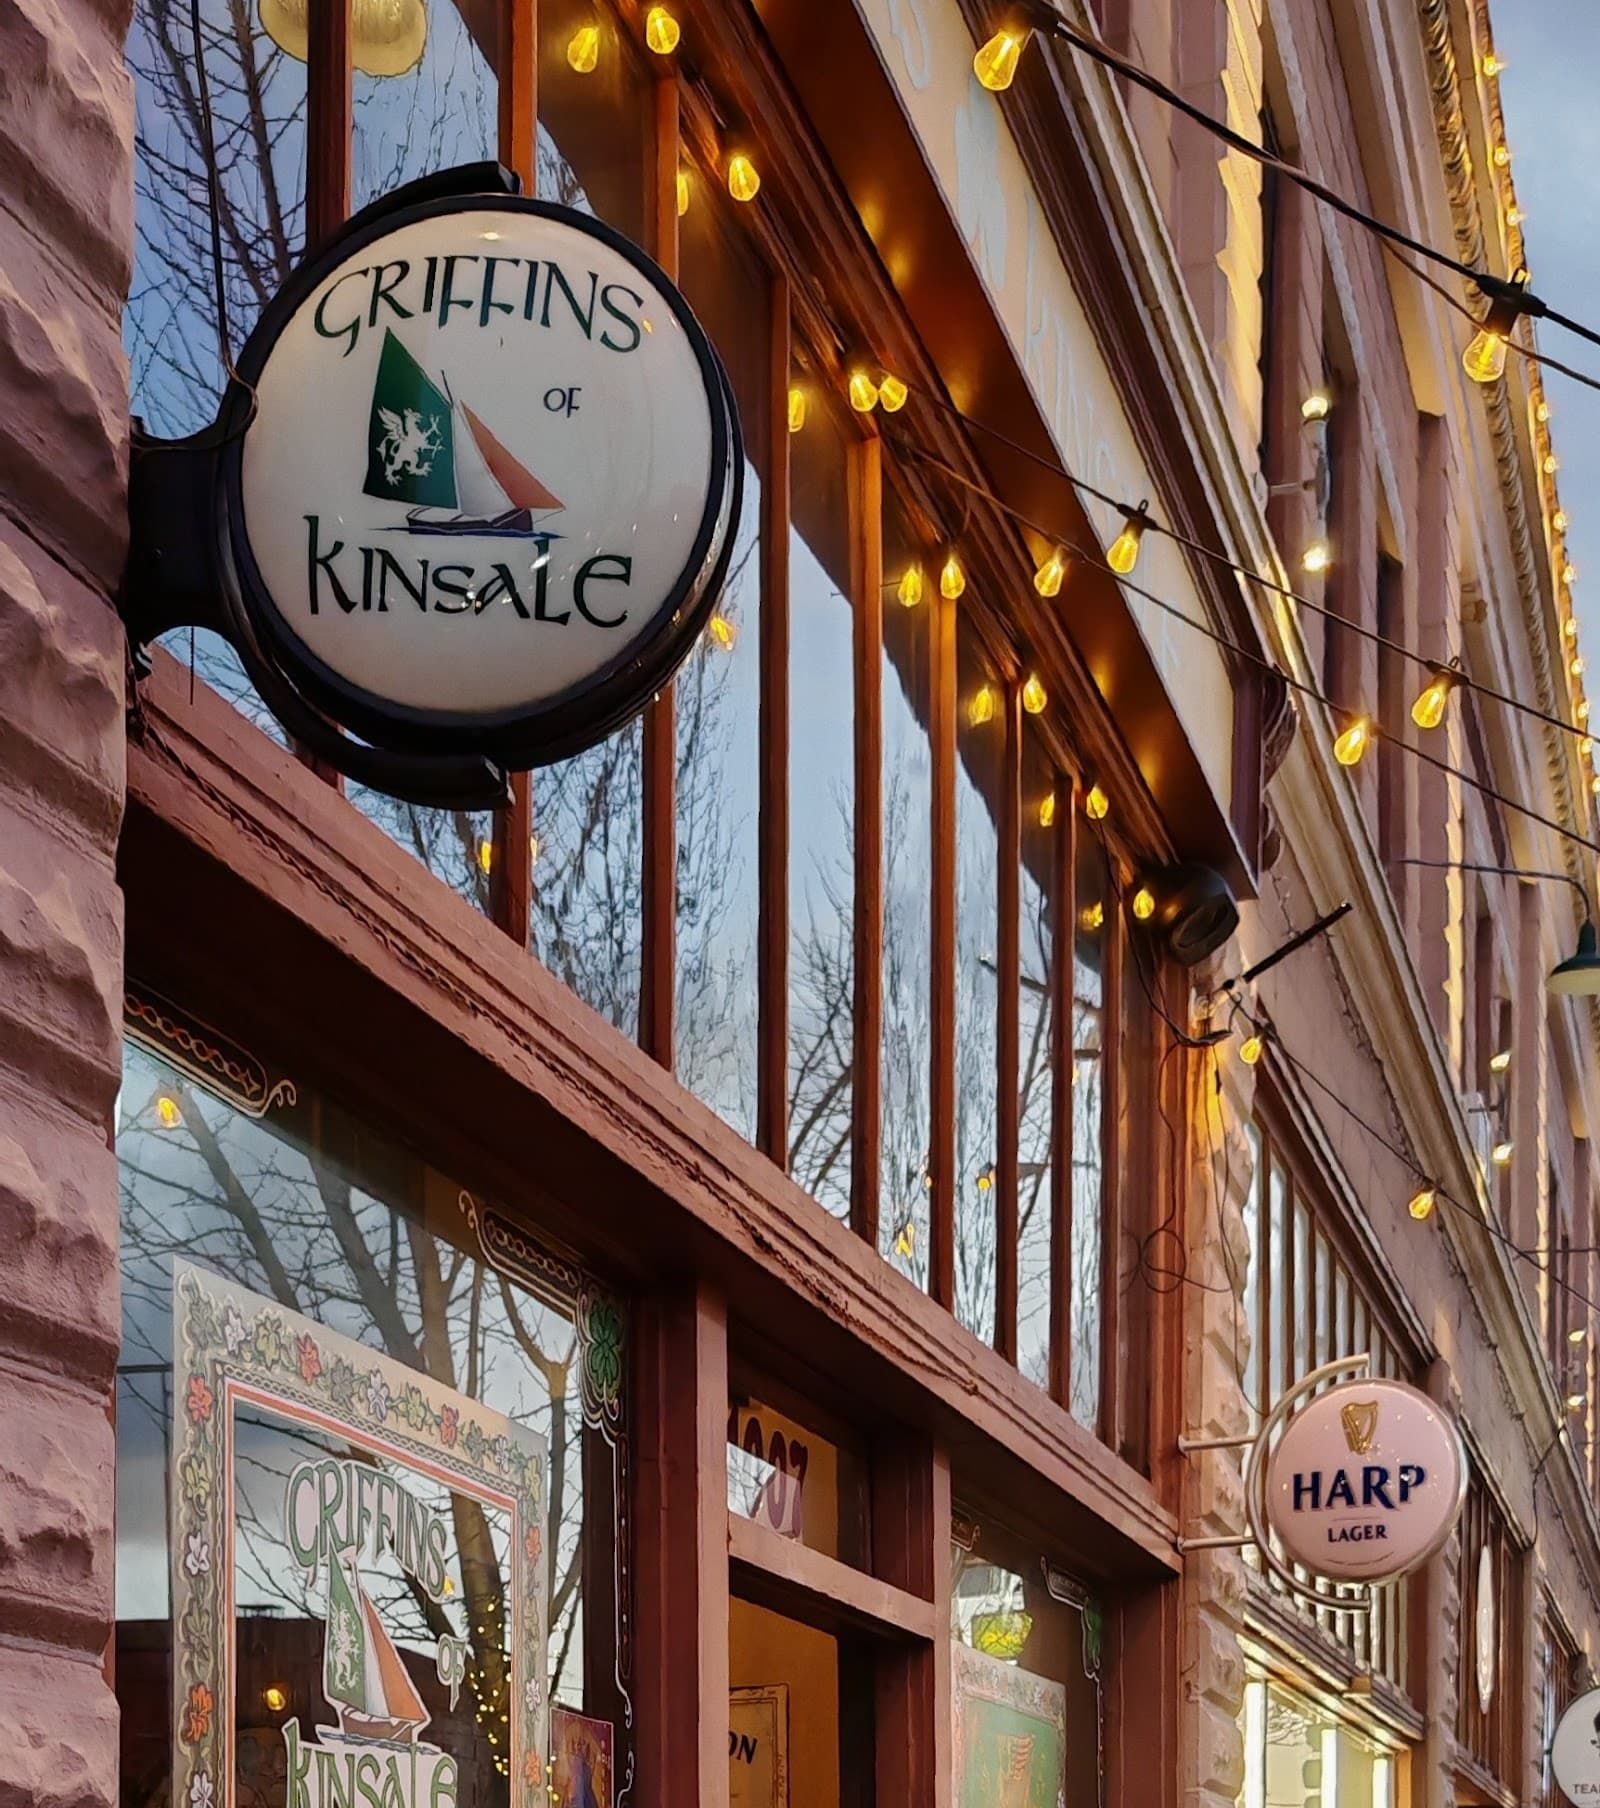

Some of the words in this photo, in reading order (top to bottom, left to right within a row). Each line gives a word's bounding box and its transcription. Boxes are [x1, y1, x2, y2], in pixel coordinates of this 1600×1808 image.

[311, 254, 645, 358] GRIFFINS
[542, 386, 583, 420] OF
[302, 514, 634, 629] KINSALE
[1292, 1464, 1426, 1512] HARP
[286, 1459, 449, 1600] GRIFFINS
[1327, 1524, 1388, 1543] LAGER
[437, 1634, 468, 1712] OF
[1571, 1783, 1600, 1795] TEA
